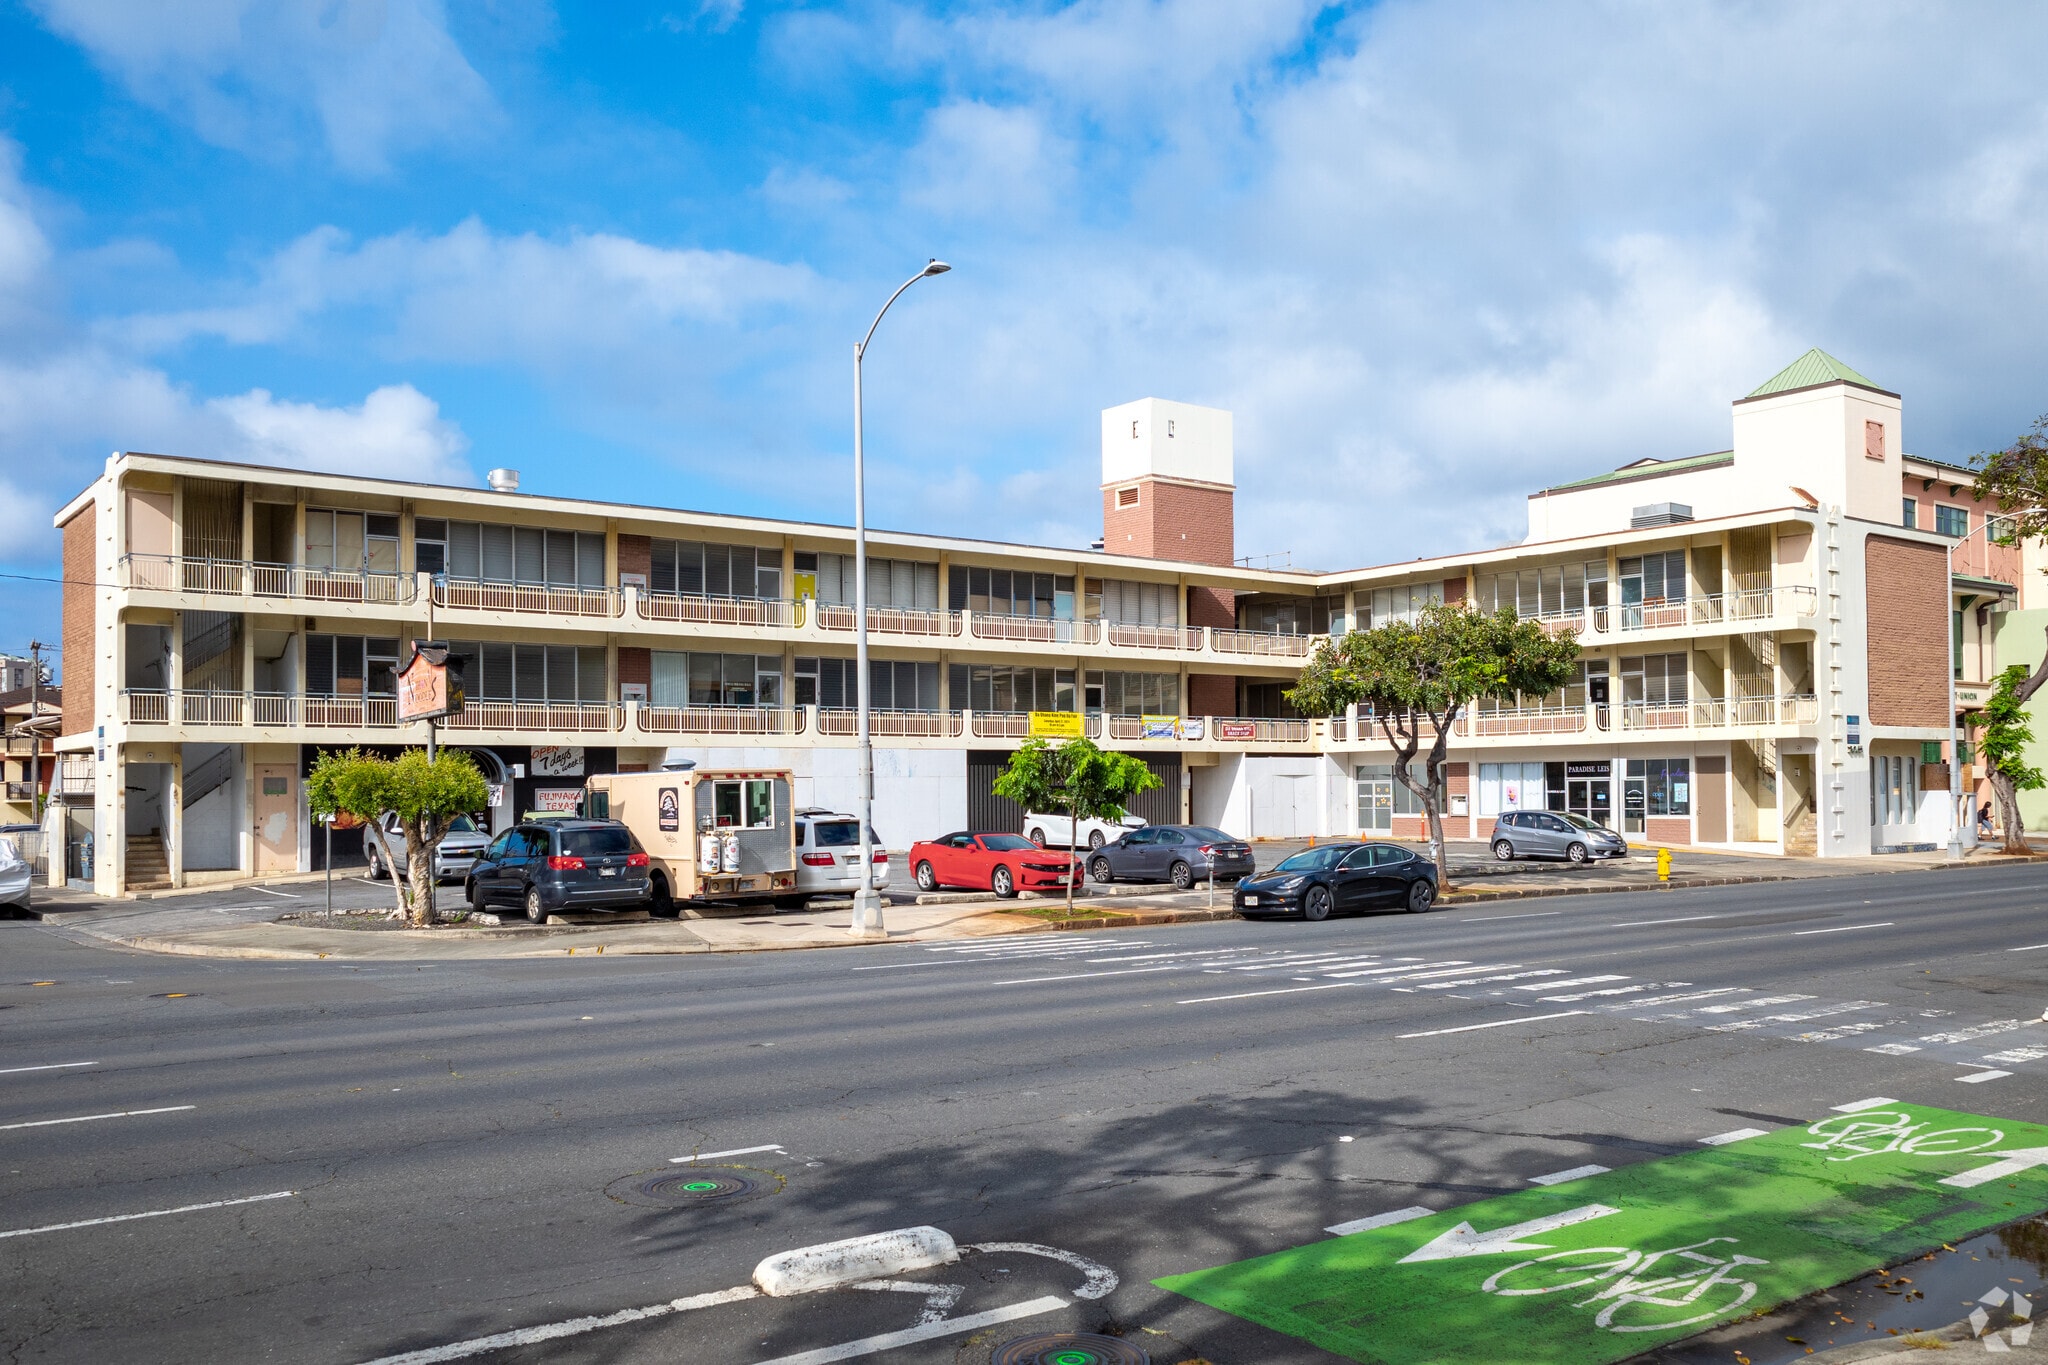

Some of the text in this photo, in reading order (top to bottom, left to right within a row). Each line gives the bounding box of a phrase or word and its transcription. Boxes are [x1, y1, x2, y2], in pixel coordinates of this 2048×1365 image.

[1960, 692, 1978, 701] UNION
[531, 745, 559, 759] OPEN
[540, 747, 571, 770] 7 days
[1568, 765, 1596, 773] PARADISE
[539, 792, 581, 801] FUJIYAMA
[546, 802, 575, 811] TEXAS
